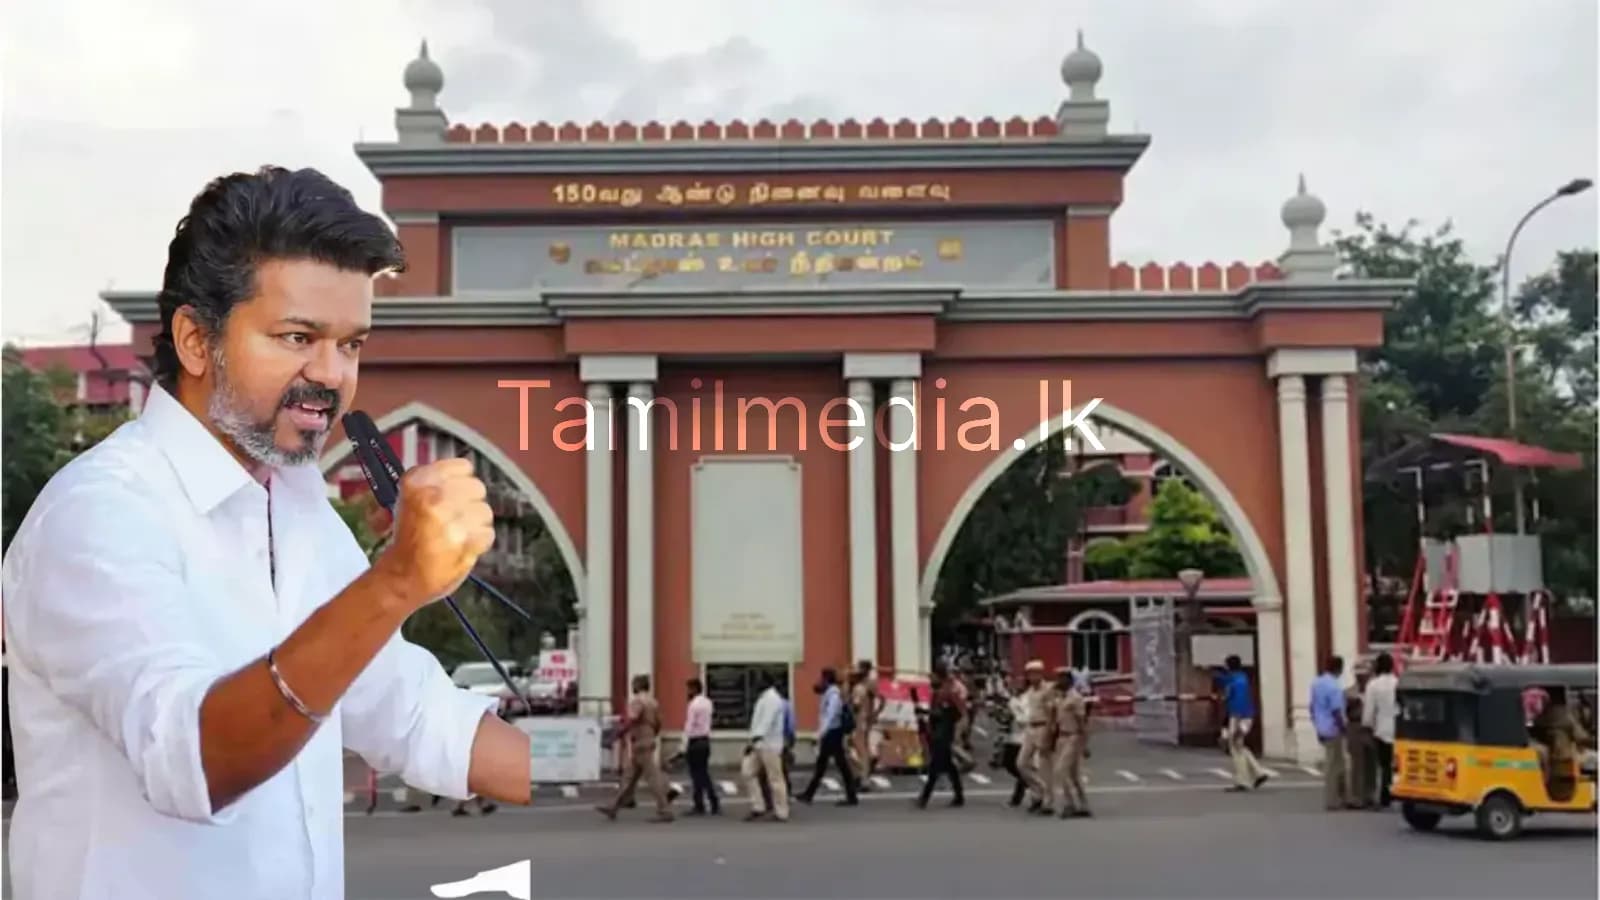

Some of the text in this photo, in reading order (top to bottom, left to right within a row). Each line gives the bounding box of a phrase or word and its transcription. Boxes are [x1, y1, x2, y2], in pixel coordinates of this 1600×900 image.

[552, 183, 642, 207] 150வது
[656, 181, 736, 205] ஆண்டு
[609, 229, 895, 248] MADRAS HIGH COURT
